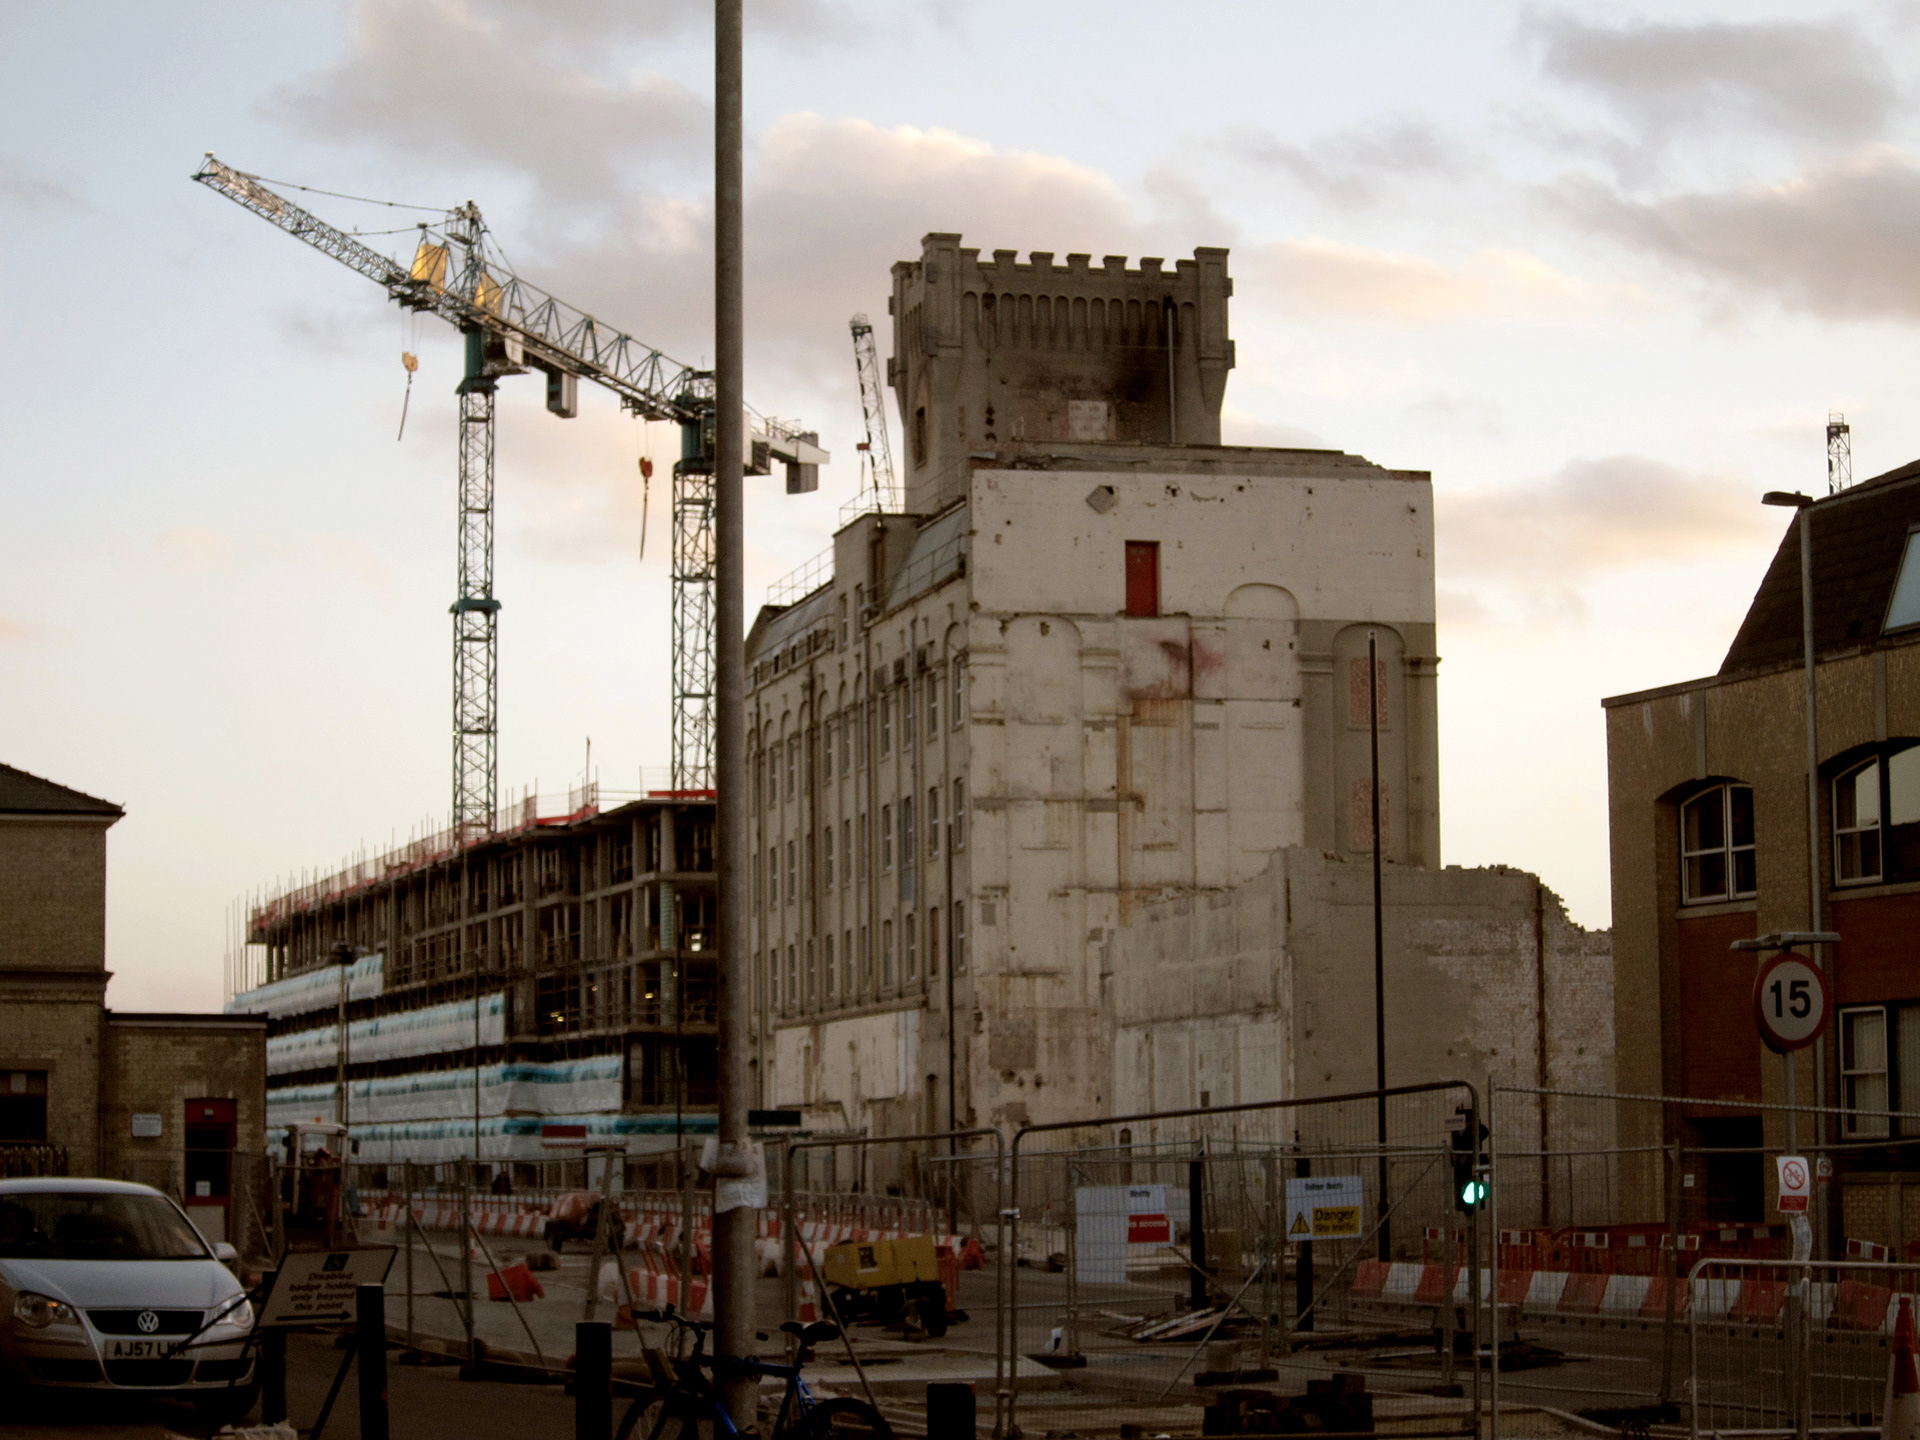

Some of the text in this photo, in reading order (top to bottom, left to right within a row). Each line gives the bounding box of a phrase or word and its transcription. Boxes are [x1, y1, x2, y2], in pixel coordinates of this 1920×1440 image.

[1771, 981, 1811, 1018] 15
[1315, 1209, 1354, 1223] Danger
[308, 1272, 353, 1281] Disabled
[289, 1283, 321, 1292] badge
[290, 1292, 355, 1303] only beyond
[294, 1302, 344, 1311] this point
[114, 1342, 152, 1356] AJ57
